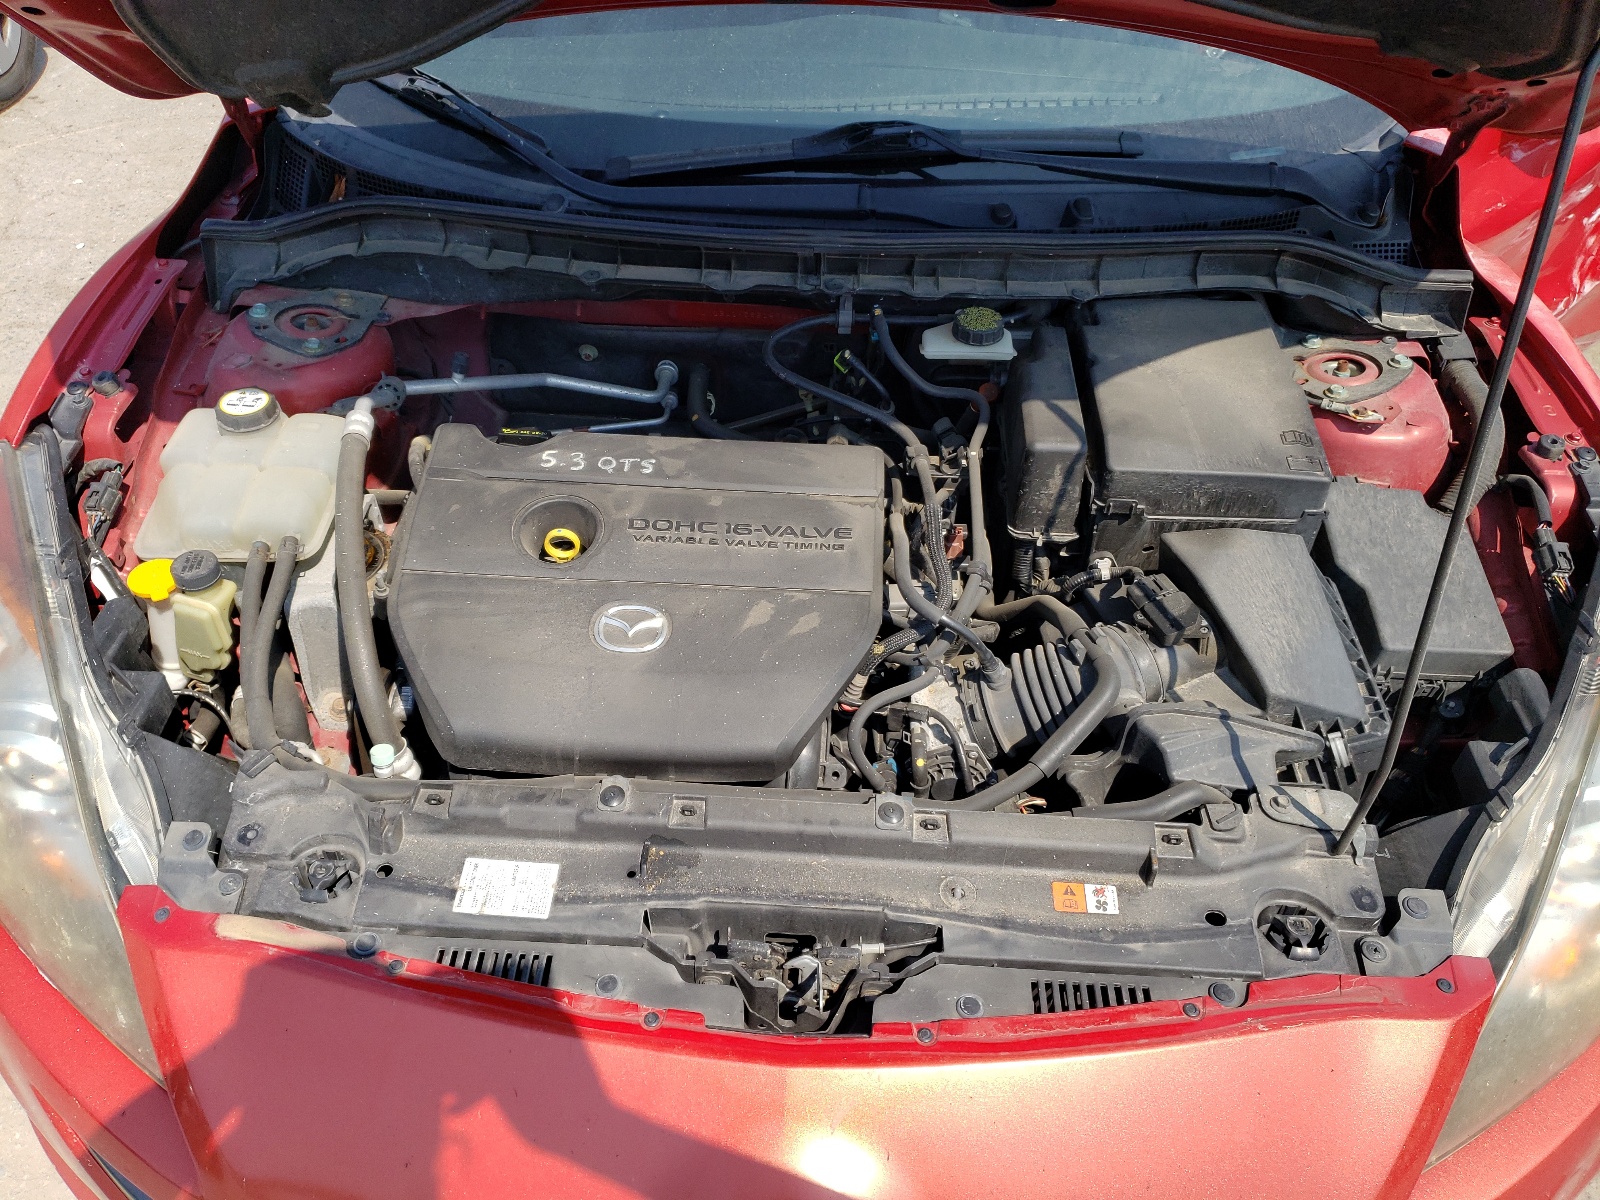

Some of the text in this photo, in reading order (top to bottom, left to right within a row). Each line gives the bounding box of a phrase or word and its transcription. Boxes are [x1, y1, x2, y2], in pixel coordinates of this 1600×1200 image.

[540, 450, 657, 474] 5.3 QTS
[627, 518, 853, 540] DOHC 16-VALVE
[632, 534, 845, 551] VARIABLE VALVE TIMING
